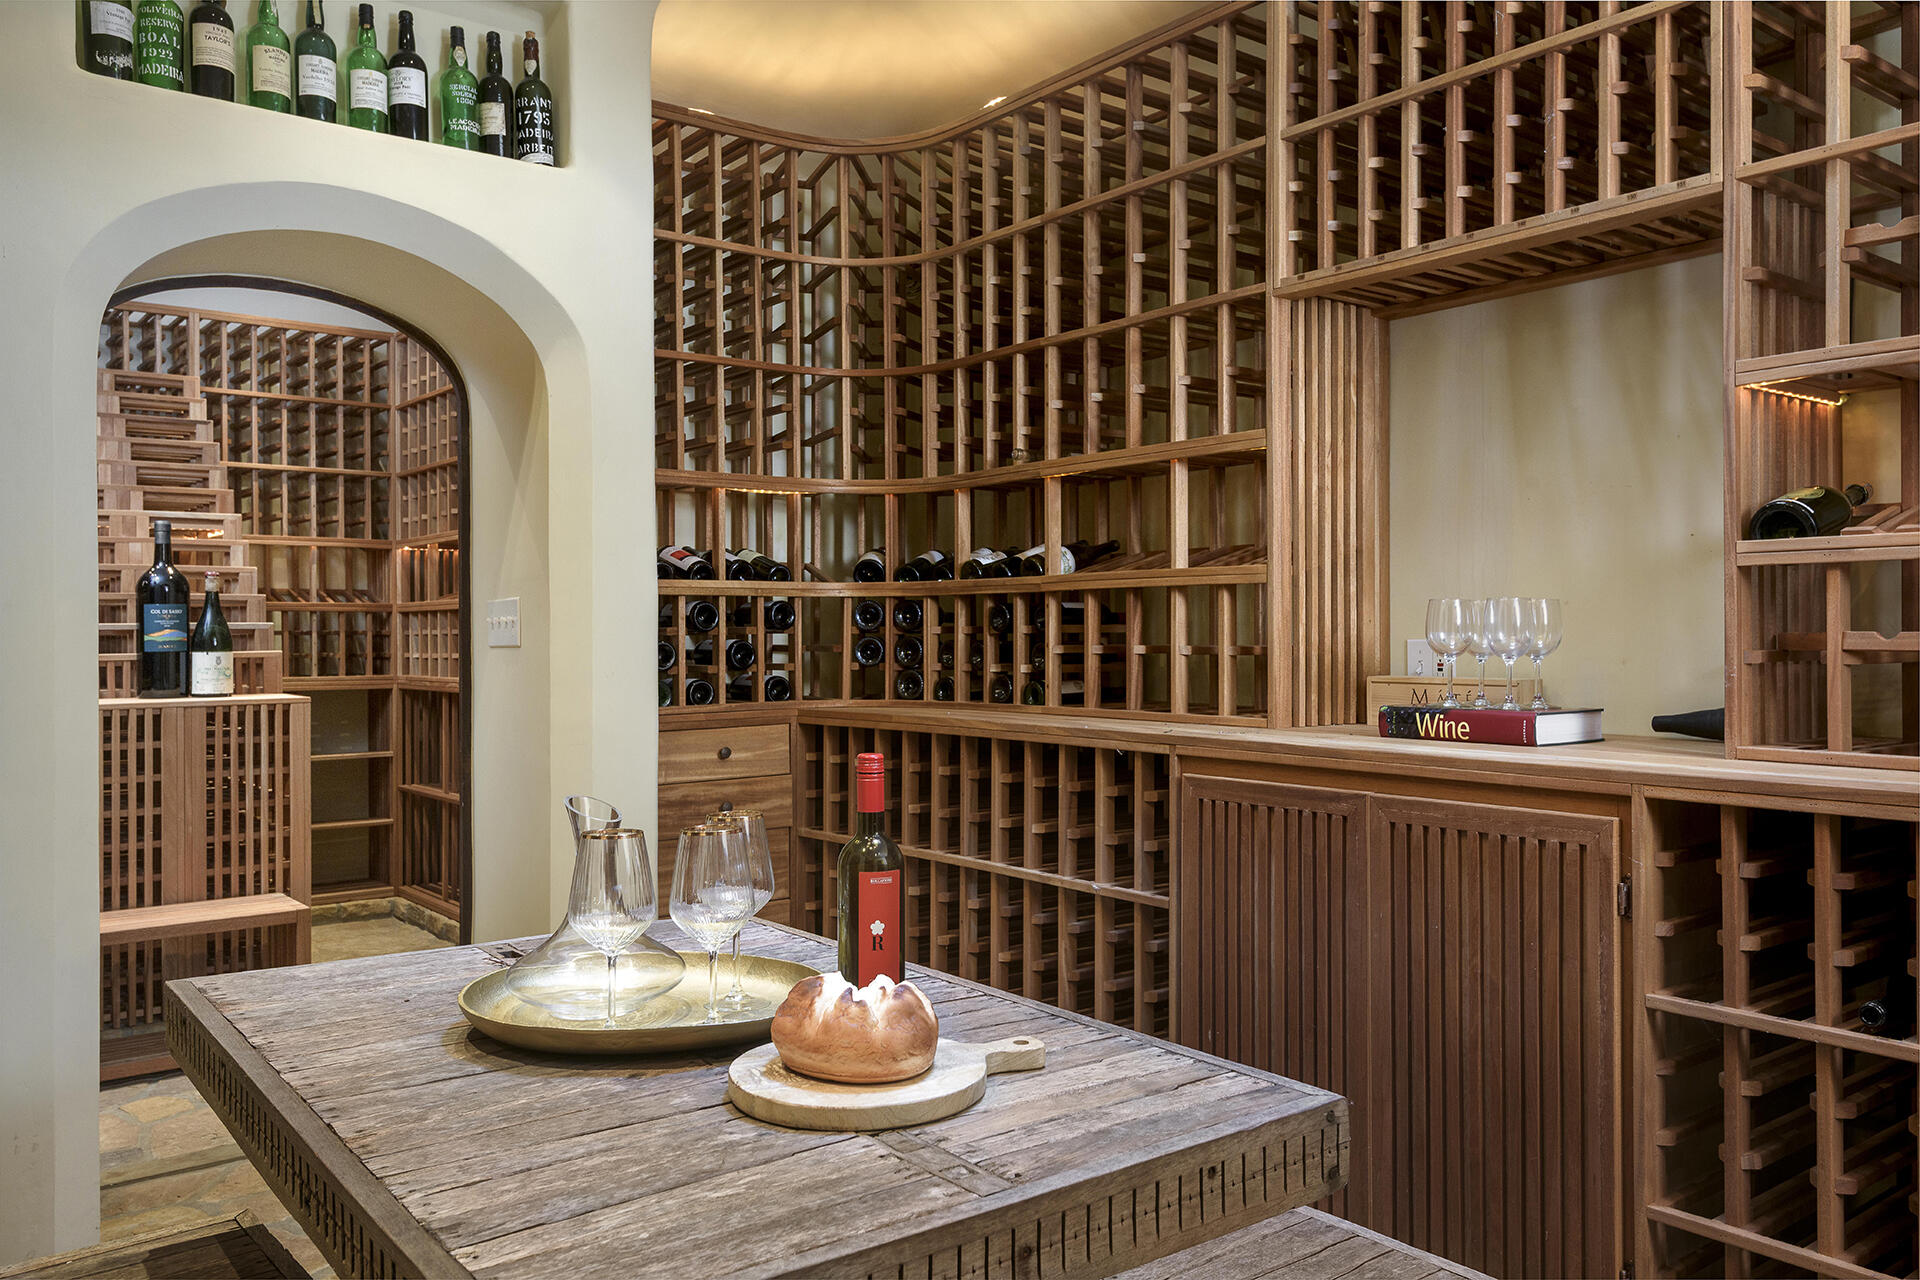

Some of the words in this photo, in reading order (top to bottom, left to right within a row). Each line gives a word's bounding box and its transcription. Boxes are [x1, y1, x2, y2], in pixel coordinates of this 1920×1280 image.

[140, 17, 180, 32] RESERVA
[139, 31, 180, 49] BOAL
[143, 47, 173, 60] 1922
[518, 110, 551, 126] 1795
[1415, 711, 1471, 741] Wine
[872, 935, 884, 951] R
